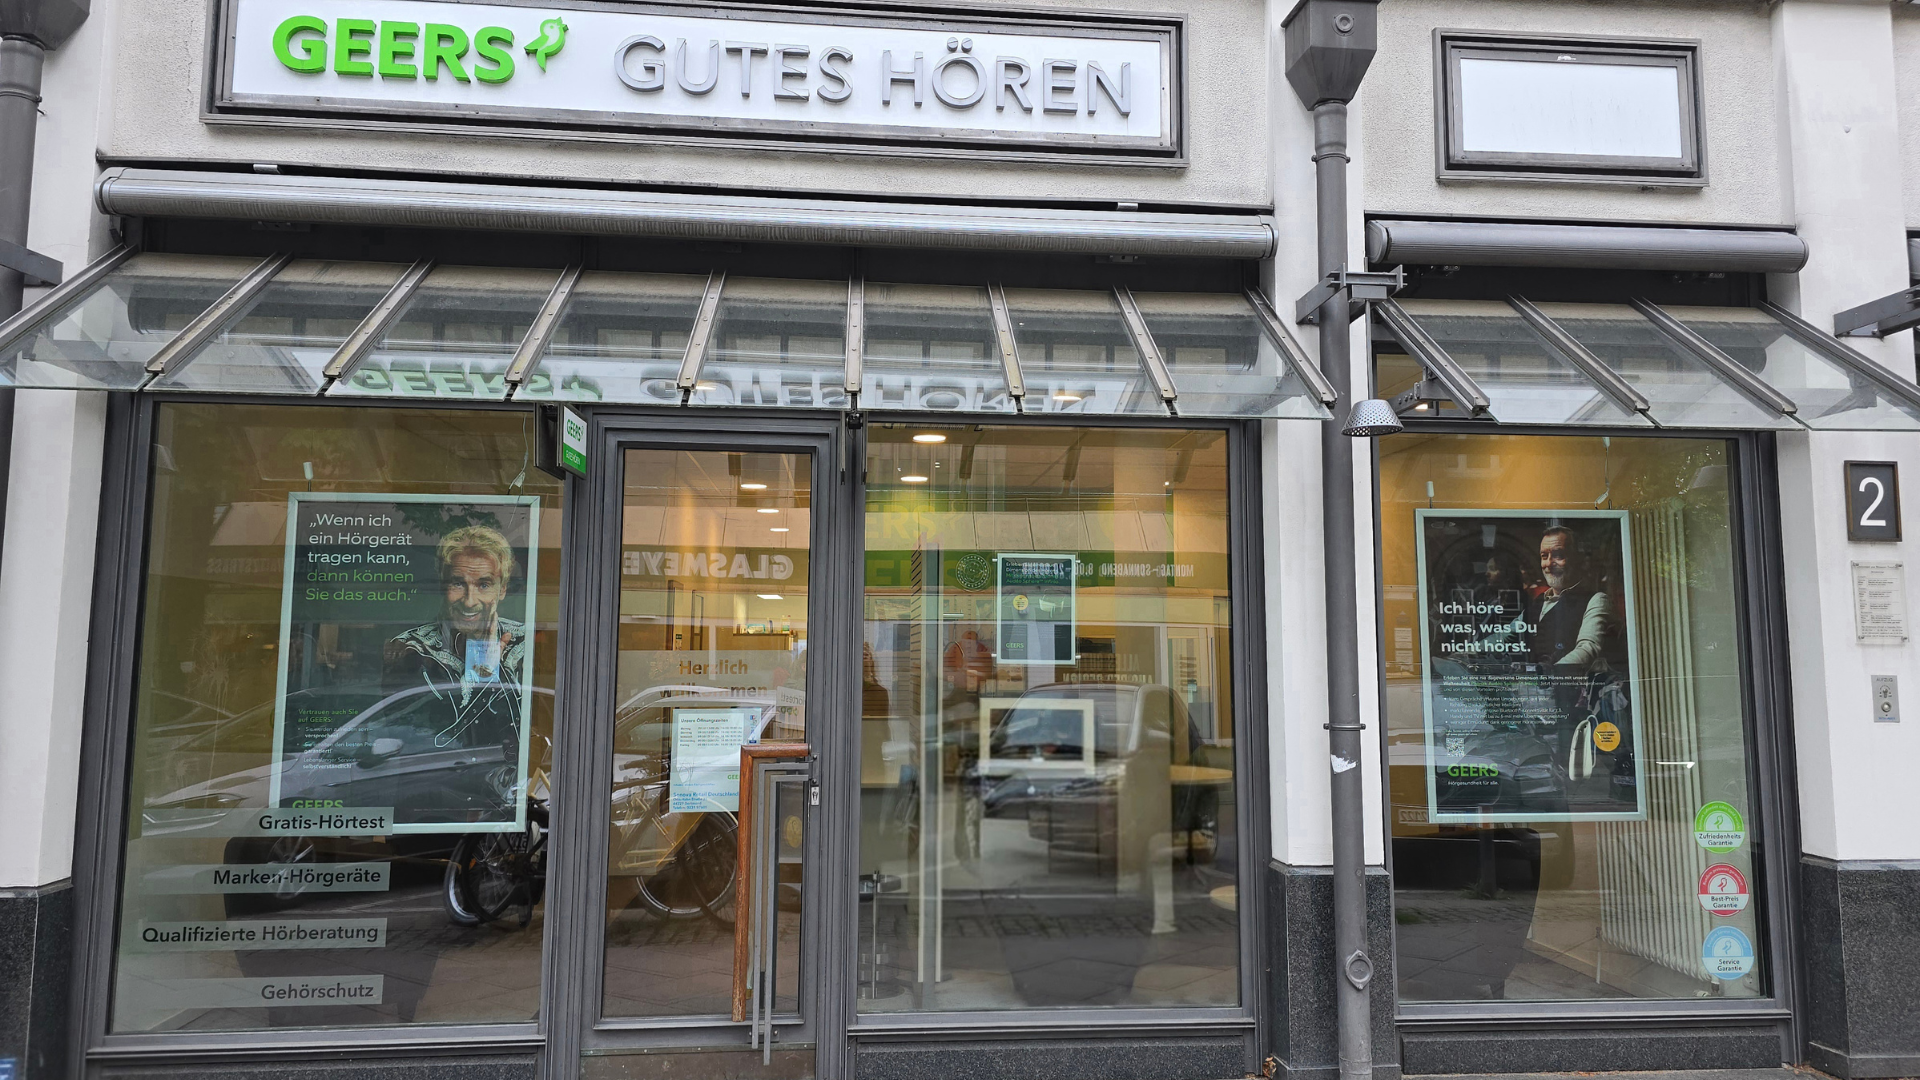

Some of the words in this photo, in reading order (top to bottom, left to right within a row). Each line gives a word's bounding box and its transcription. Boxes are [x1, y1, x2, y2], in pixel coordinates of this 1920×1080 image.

[272, 15, 515, 84] GEERS
[613, 34, 854, 103] GUTES
[881, 37, 1132, 118] HÖREN
[1858, 476, 1887, 527] 2
[309, 513, 364, 528] „Wenn
[368, 513, 392, 527] ich
[309, 533, 333, 545] ein
[338, 532, 412, 548] Hörgerät
[307, 552, 362, 566] tragen
[367, 551, 410, 566] kann,
[307, 570, 348, 582] dann
[353, 570, 414, 582] können
[305, 588, 329, 601] Sie
[333, 588, 363, 601] das
[366, 588, 417, 601] auch.“
[1439, 602, 1463, 614] Ich
[1466, 601, 1504, 614] höre
[1441, 622, 1477, 635] was,
[1480, 622, 1512, 634] was
[1515, 620, 1538, 634] Du
[1441, 639, 1481, 652] nicht
[1484, 639, 1531, 652] hörst.
[679, 659, 748, 675] Herzlich
[1448, 764, 1499, 778] GEERS
[258, 813, 385, 830] Gratis-Hörtest
[213, 868, 381, 887] Marken-Hörgeräte
[142, 926, 256, 943] Qualifizierte
[262, 924, 379, 942] Hörberatung
[261, 982, 374, 1000] Gehörschutz
